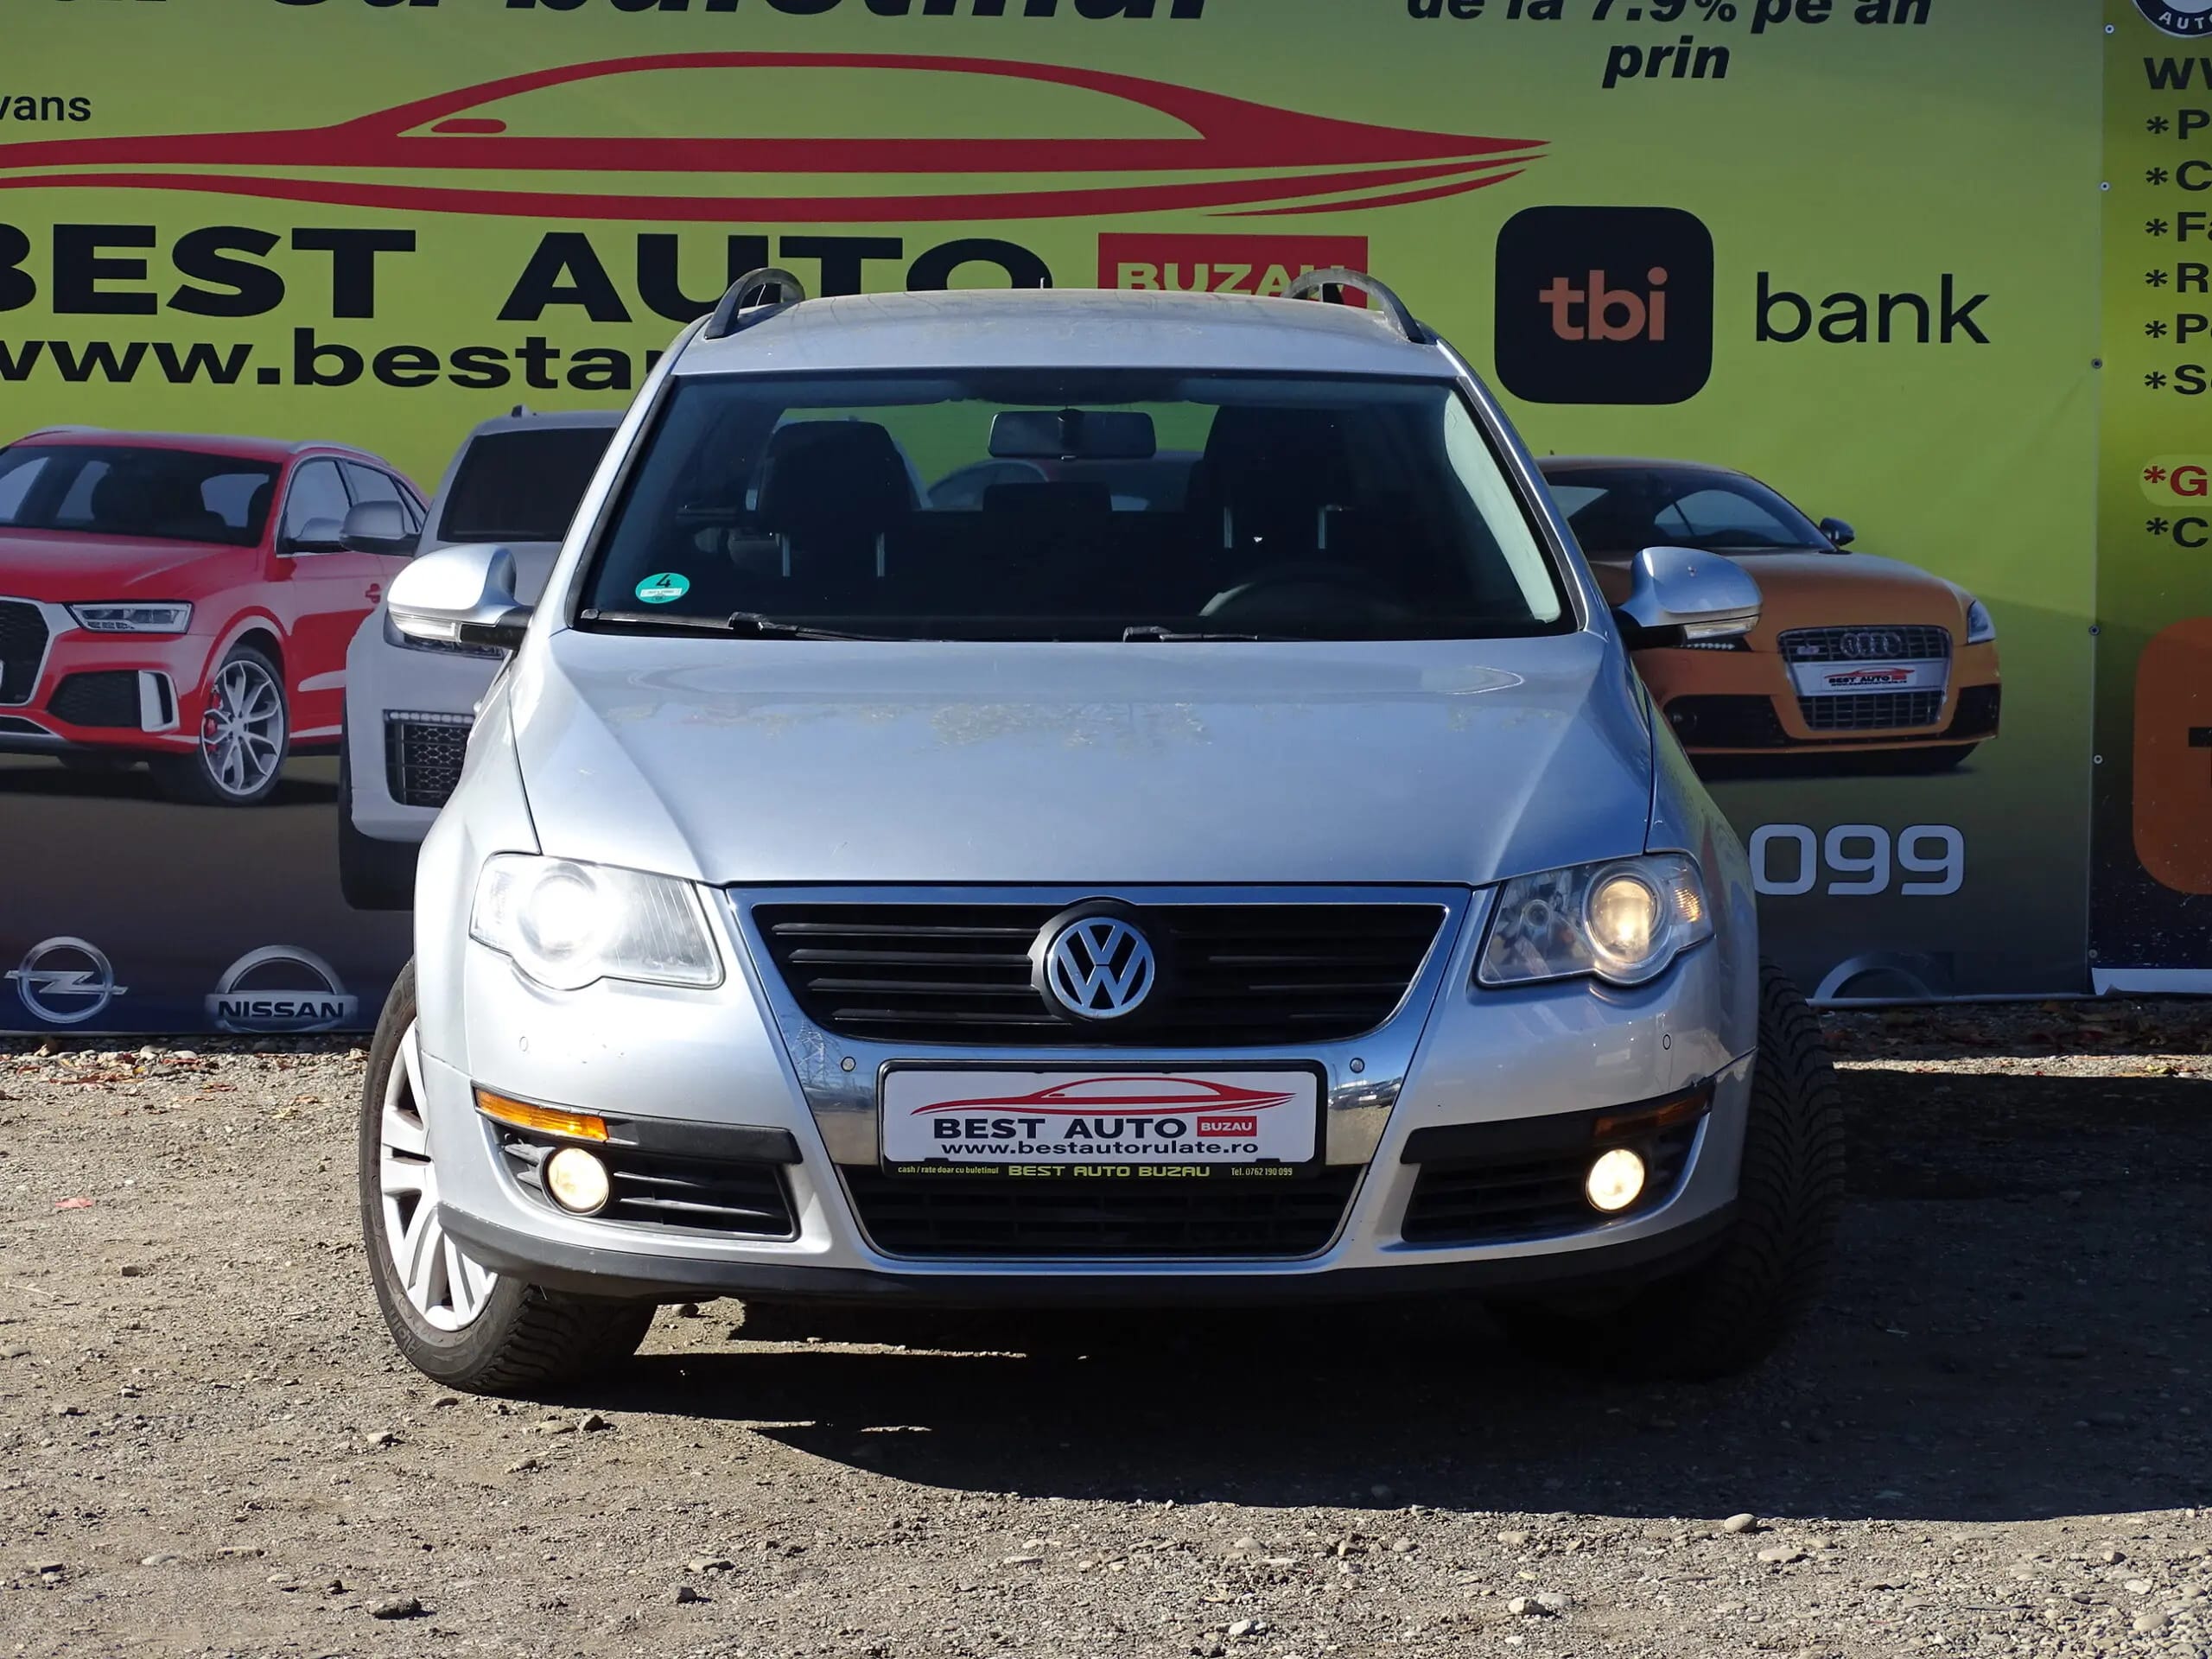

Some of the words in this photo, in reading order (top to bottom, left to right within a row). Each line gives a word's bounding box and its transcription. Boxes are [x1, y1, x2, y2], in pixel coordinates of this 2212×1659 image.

[1602, 35, 1730, 88] prin
[1538, 266, 1668, 341] tbi
[1756, 271, 1991, 344] bank
[655, 573, 671, 588] 4
[1748, 823, 1967, 896] 099
[218, 1001, 345, 1019] NISSAN
[933, 1118, 1046, 1139] BEST
[1063, 1118, 1187, 1139] AUTO
[1200, 1122, 1253, 1132] BUZAU
[941, 1141, 1259, 1154] www.bestautorulate.ro
[965, 1166, 999, 1175] buletinul
[1008, 1166, 1065, 1177] BEST
[1073, 1166, 1131, 1177] AUTO
[1138, 1166, 1211, 1177] BUZAU
